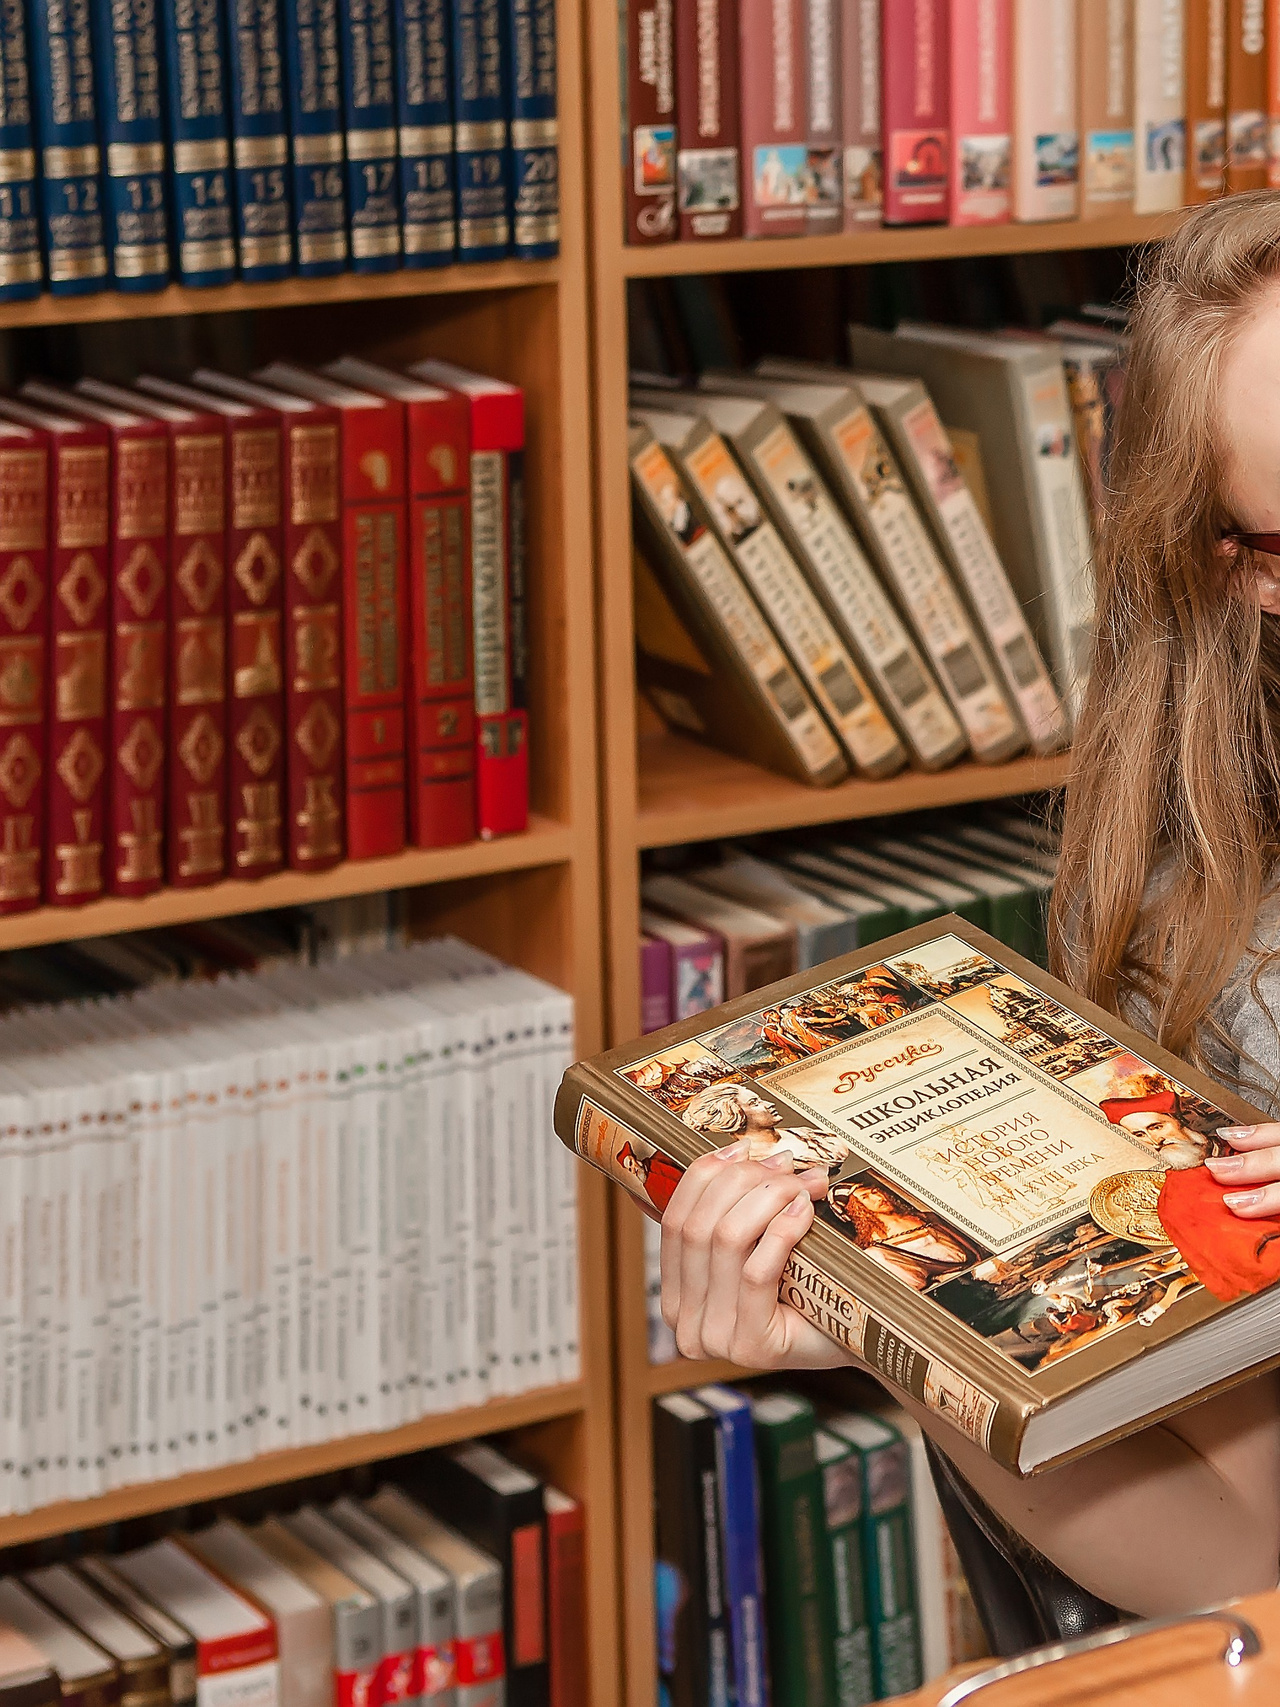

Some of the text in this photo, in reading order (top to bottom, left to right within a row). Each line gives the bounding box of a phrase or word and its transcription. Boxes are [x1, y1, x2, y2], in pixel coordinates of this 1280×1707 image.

[191, 174, 226, 205] 14
[253, 169, 284, 200] 15
[311, 167, 343, 199] 16
[363, 162, 395, 194] 17
[415, 159, 447, 188] 18
[0, 186, 31, 218] 11
[63, 179, 98, 213] 12
[126, 177, 162, 210] 13
[833, 1042, 943, 1094] Руссика
[846, 1057, 1004, 1130] ШКОЛЬНАЯ
[869, 1073, 1022, 1144] ЭНЦИКЛОПЕДИЯ
[937, 1111, 1041, 1163] ИСТОРИЯ
[964, 1129, 1050, 1171] НОВОГО
[979, 1139, 1074, 1187] ВРЕМЕНИ
[1062, 1152, 1105, 1175] ВЕКА
